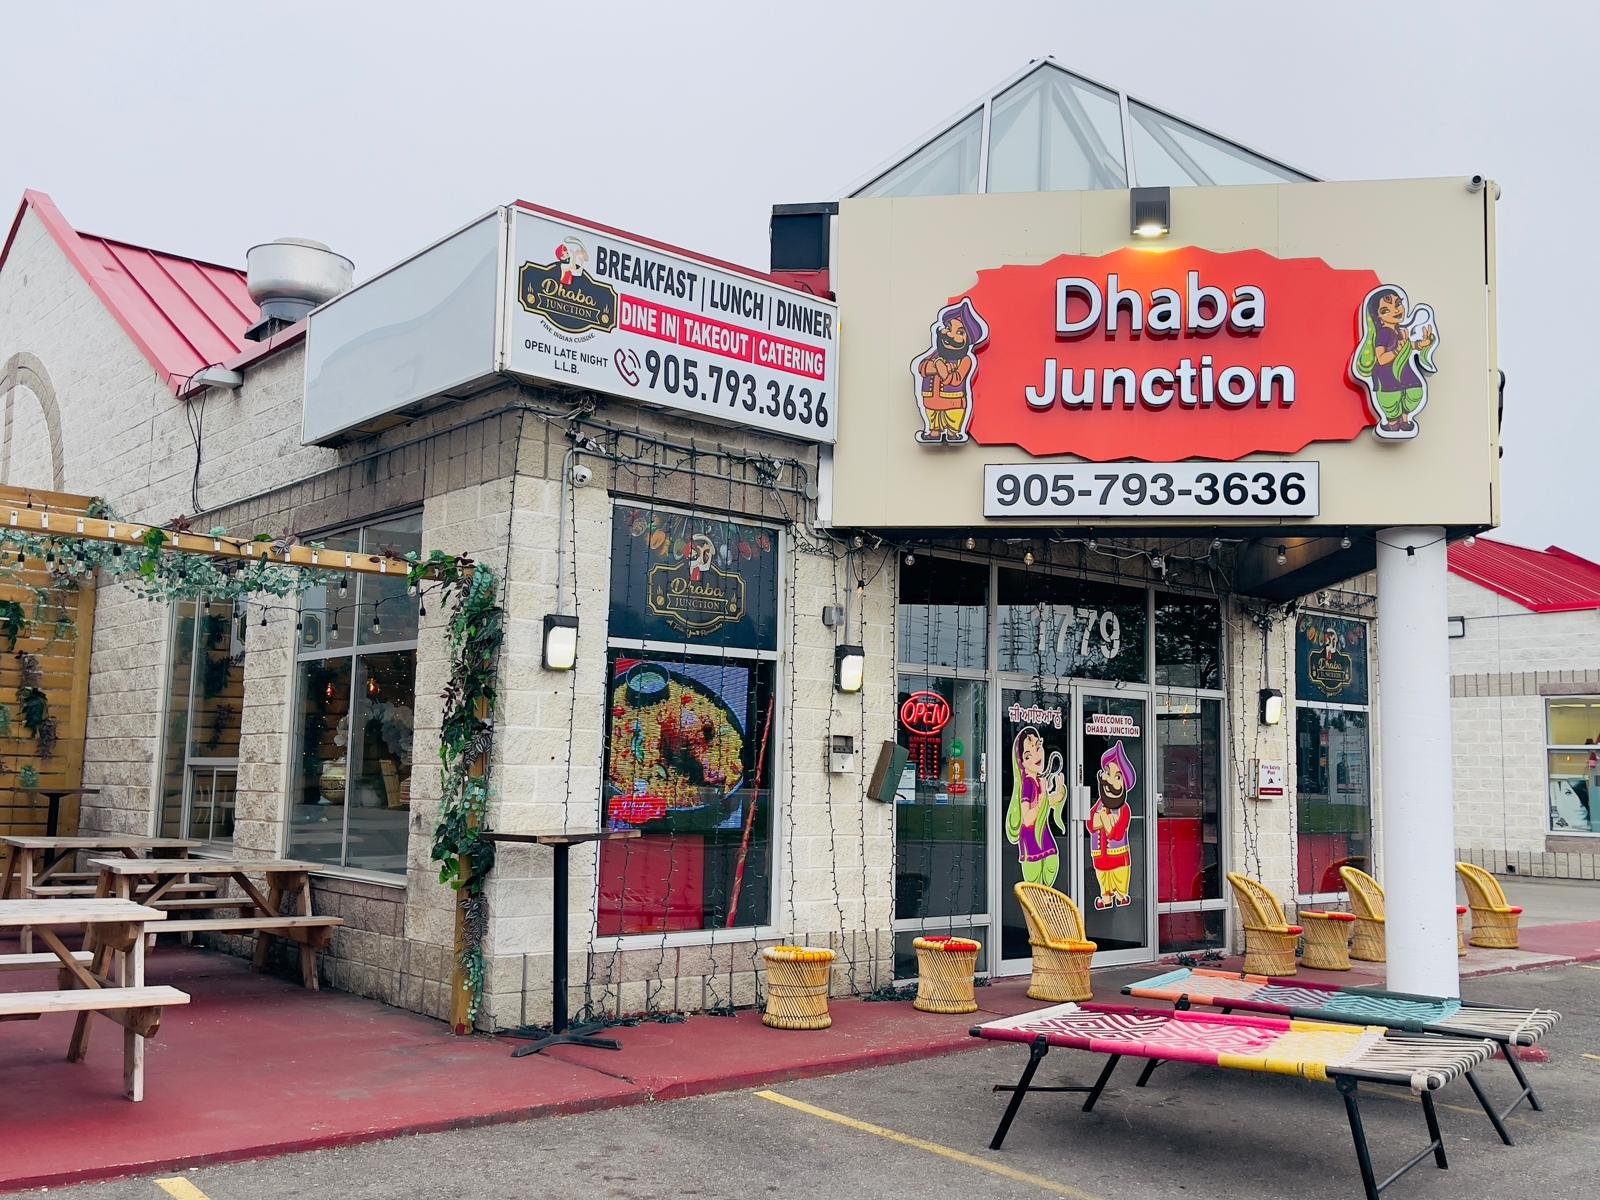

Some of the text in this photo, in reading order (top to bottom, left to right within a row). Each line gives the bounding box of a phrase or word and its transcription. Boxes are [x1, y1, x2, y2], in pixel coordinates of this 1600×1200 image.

[541, 278, 597, 306] Dhaba
[595, 245, 833, 340] BREAKFAST LUNCH DINNER
[1055, 270, 1266, 336] Dhaba
[545, 298, 593, 318] JUNCTION
[553, 332, 573, 343] INDIAN
[621, 299, 824, 376] DINE IN TAKEOUT CATERING
[524, 339, 608, 368] OPEN LATE NIGHT
[554, 359, 580, 374] L.L.B.
[645, 349, 829, 428] 905.793.3636
[1025, 355, 1296, 407] Junction
[995, 471, 1307, 507] 905-793-3636
[670, 577, 725, 597] Dhaba
[675, 597, 720, 610] JUNCTION
[1030, 602, 1120, 659] 1779
[903, 701, 945, 724] OPEN
[1093, 716, 1133, 725] WELCOME TO
[1087, 726, 1139, 736] DHABA JUNCTION
